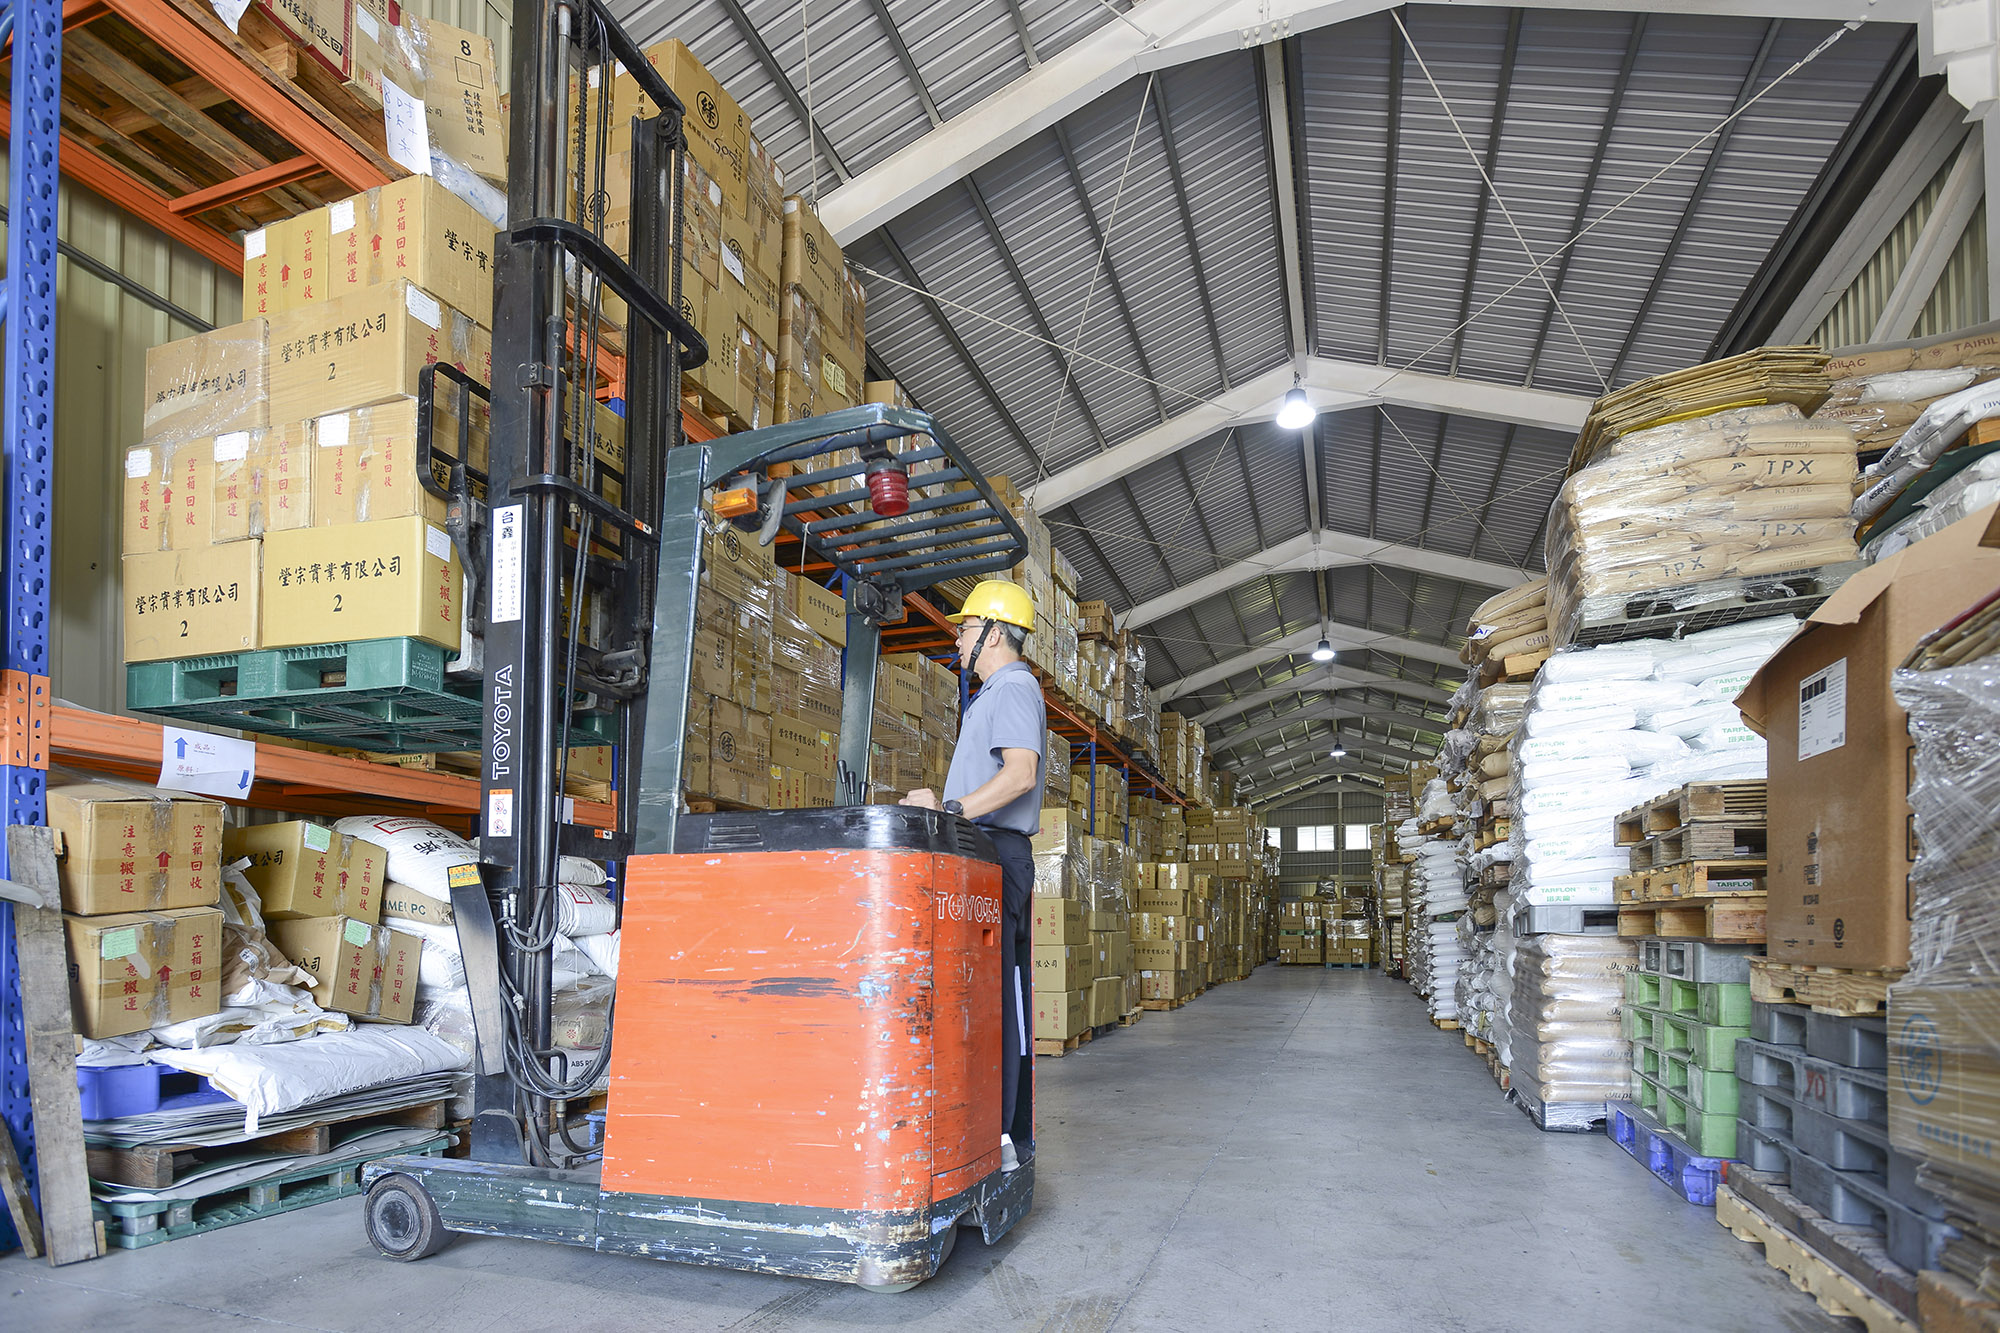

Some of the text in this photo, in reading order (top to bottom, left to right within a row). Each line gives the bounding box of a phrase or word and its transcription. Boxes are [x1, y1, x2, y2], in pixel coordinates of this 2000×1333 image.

[460, 39, 472, 57] 8
[346, 224, 358, 284] 意搬運
[396, 197, 407, 269] 空箱回收
[257, 254, 268, 313] 意搬運
[303, 229, 314, 300] 空箱回收
[1953, 337, 1999, 353] TAIRIL
[327, 362, 337, 382] 2
[278, 440, 289, 510] 空箱回收
[384, 437, 393, 488] 空箱回收
[1767, 459, 1814, 475] TPX
[185, 458, 197, 526] 空箱回收
[227, 458, 238, 518] 意搬運
[1760, 522, 1807, 537] TPX
[1660, 555, 1706, 578] TPX
[333, 593, 344, 613] 2
[823, 617, 829, 627] 2
[179, 620, 189, 639] 2
[492, 663, 513, 781] TOYOTA
[794, 747, 800, 757] 2
[120, 825, 136, 893] 注意搬運
[190, 825, 205, 890] 空箱回收
[312, 850, 327, 899] 意搬運
[359, 858, 375, 911] 空箱回收
[935, 891, 1001, 924] TOYOTA
[1540, 886, 1577, 894] TARFLON
[1716, 880, 1754, 888] TARFLON
[411, 903, 426, 916] PC
[189, 934, 204, 998] 空箱回收
[348, 945, 364, 994] 意搬運
[392, 950, 407, 1004] 空箱回收
[570, 1059, 584, 1068] ABS
